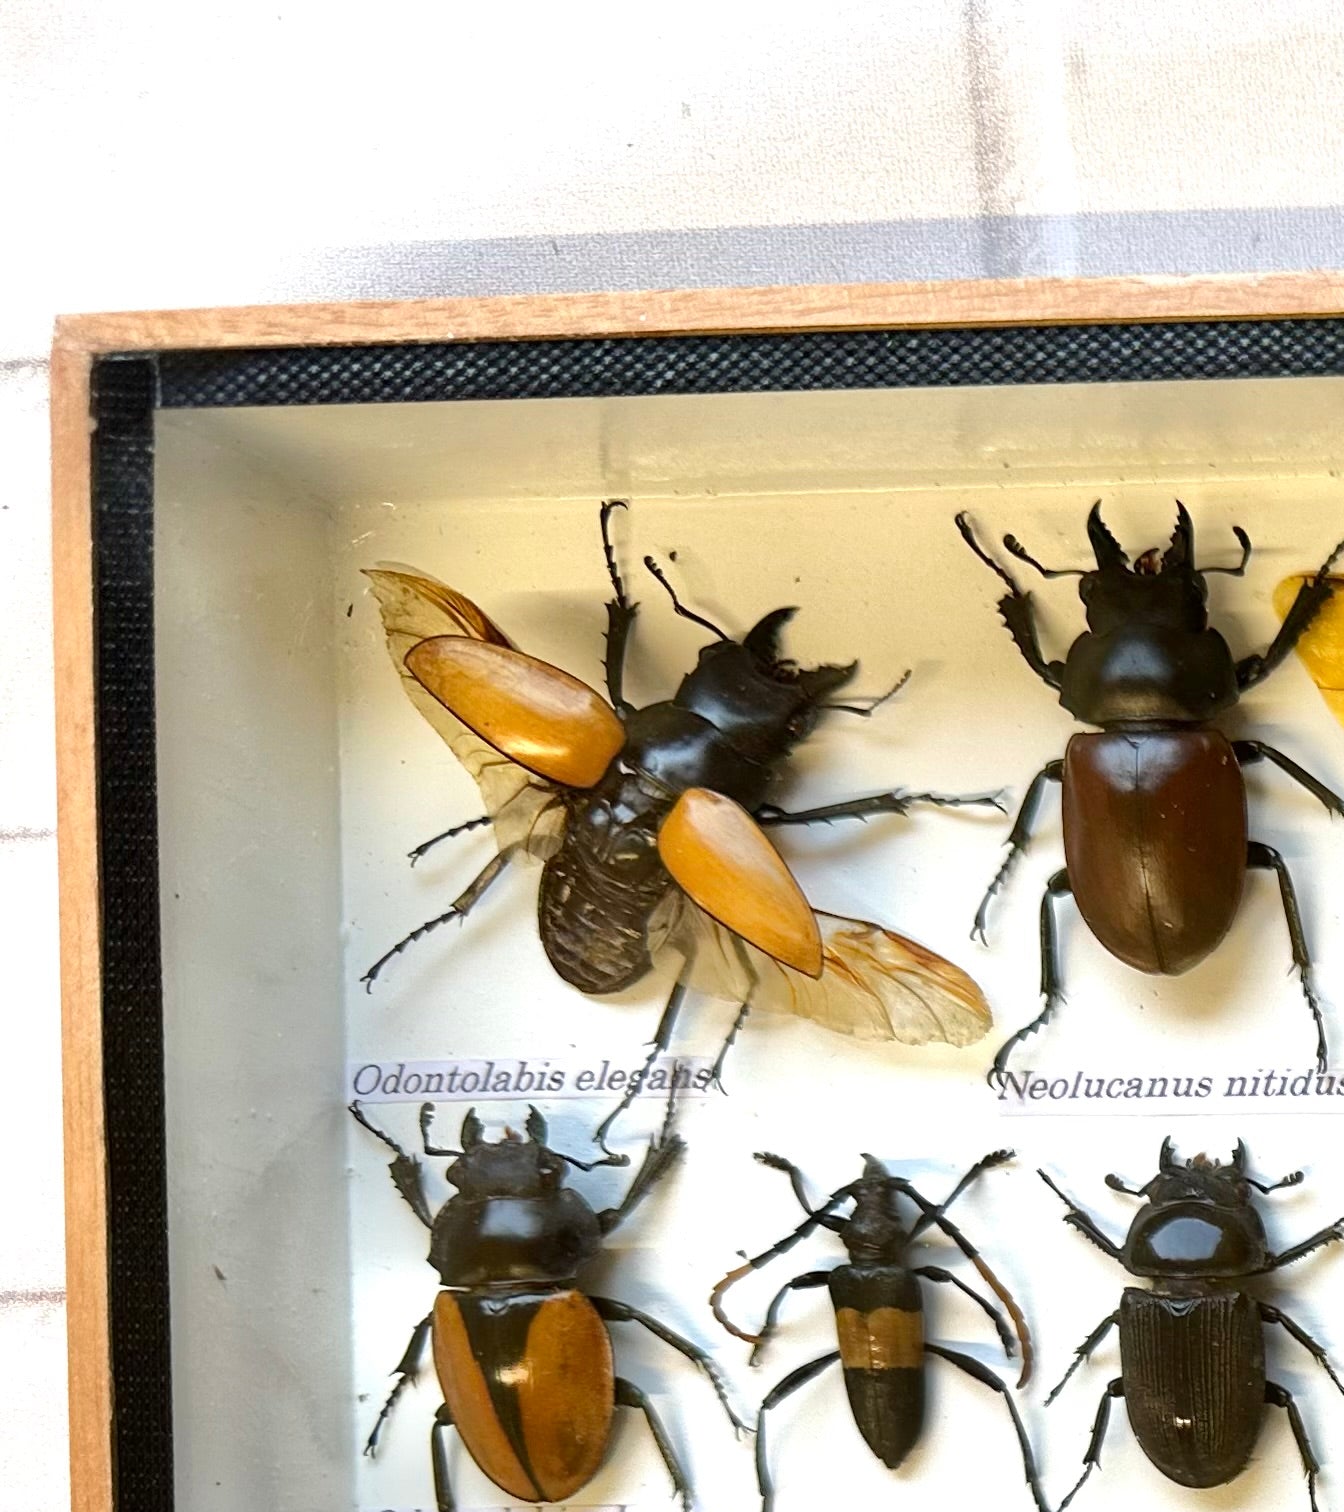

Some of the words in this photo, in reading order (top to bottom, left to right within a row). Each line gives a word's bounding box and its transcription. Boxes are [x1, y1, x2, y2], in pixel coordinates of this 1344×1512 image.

[353, 1060, 567, 1097] Odontolabis
[575, 1059, 713, 1097] elegans
[997, 1070, 1213, 1101] Neolucanus
